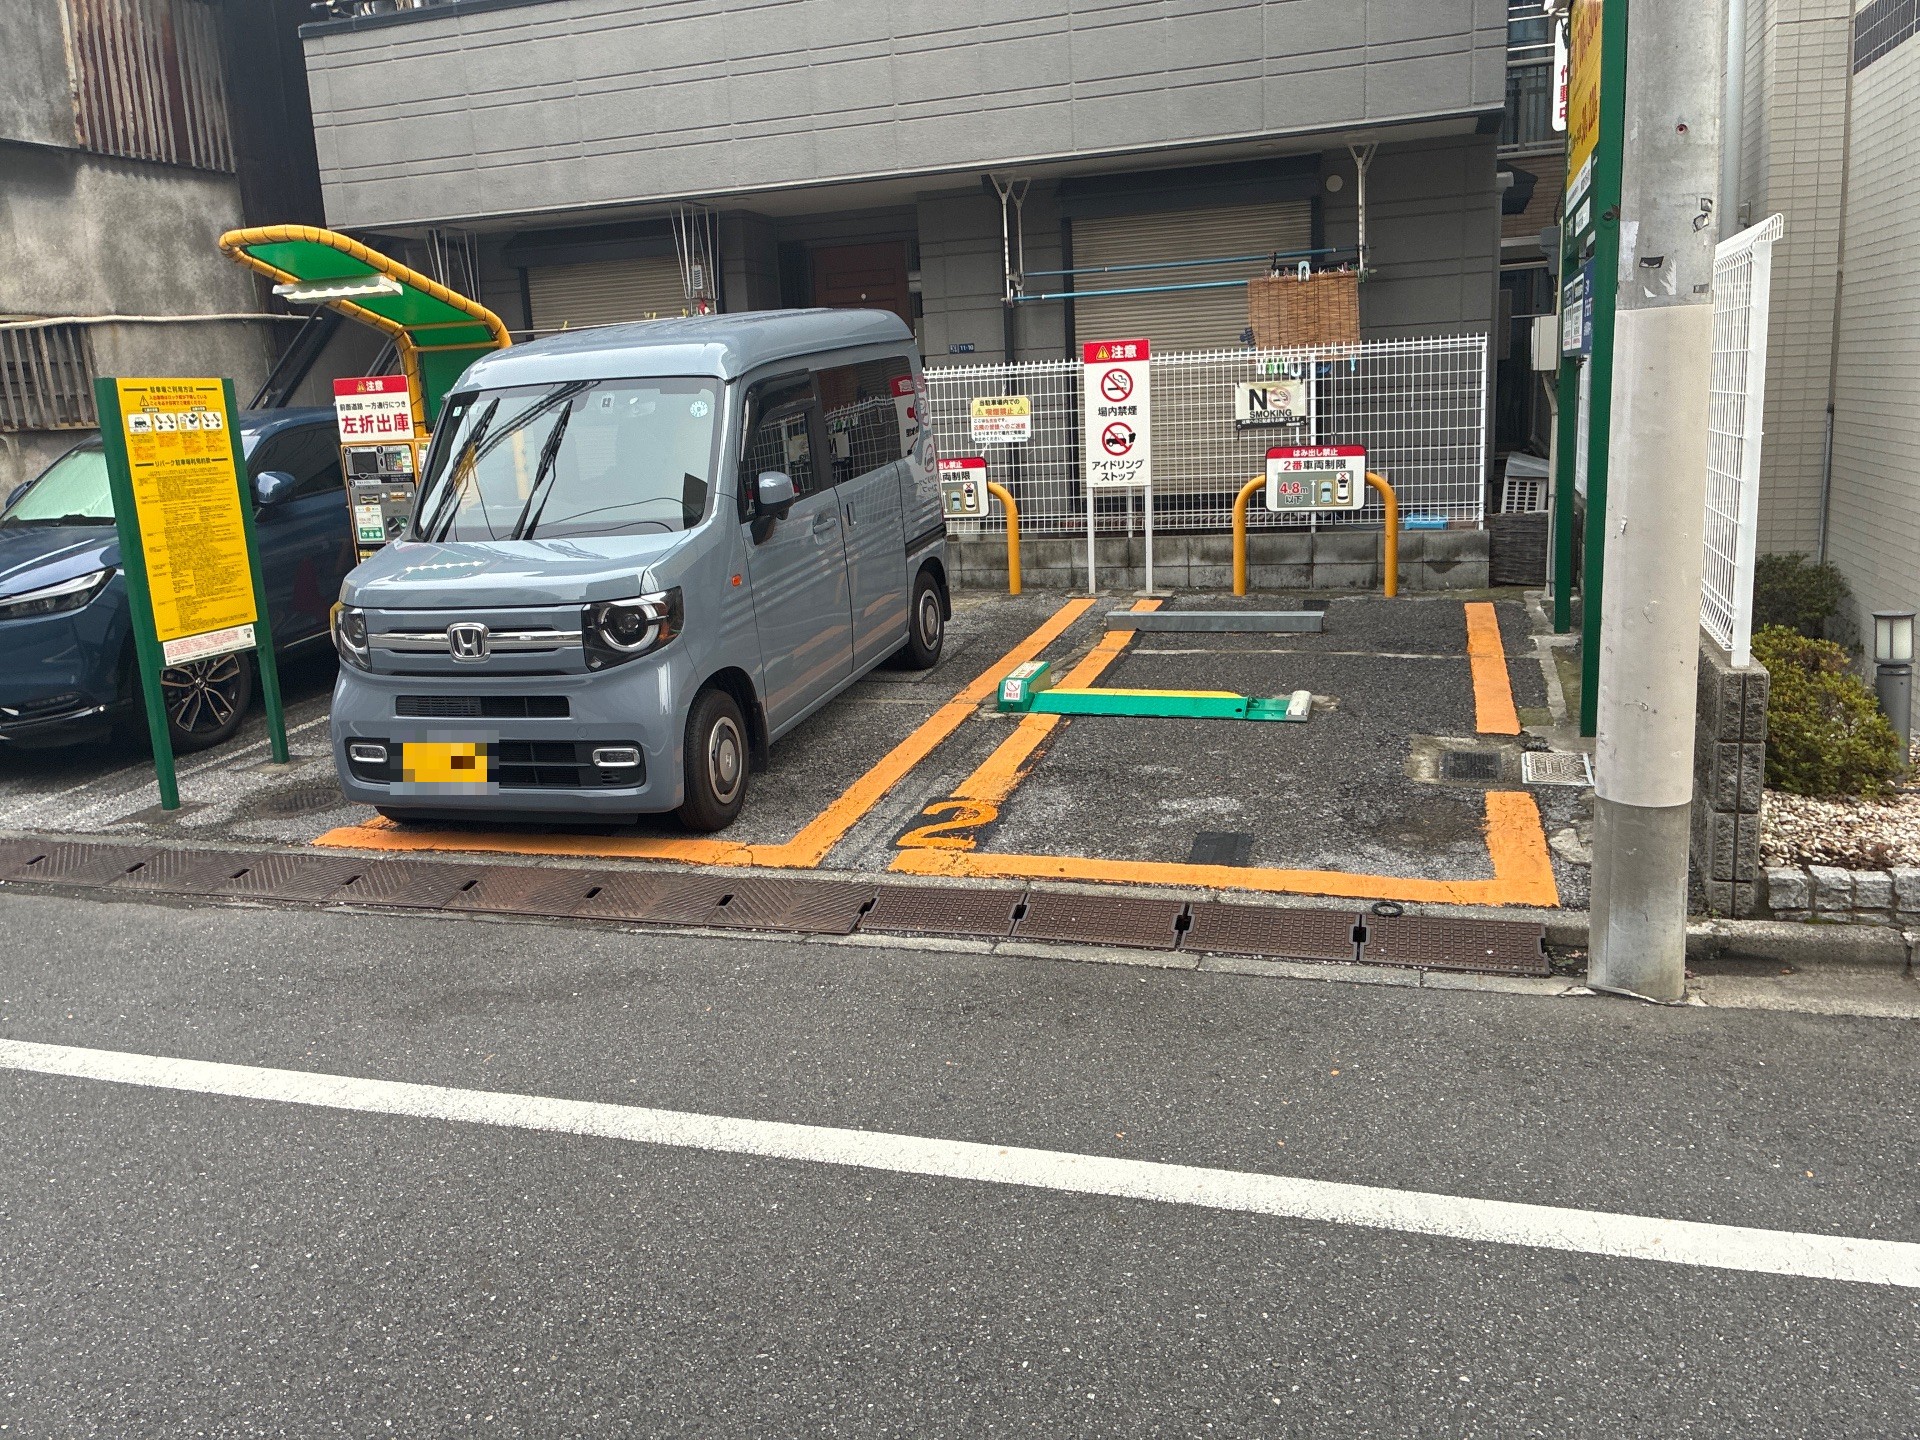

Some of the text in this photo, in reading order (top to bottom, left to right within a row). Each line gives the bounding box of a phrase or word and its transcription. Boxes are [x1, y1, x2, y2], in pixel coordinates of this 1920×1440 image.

[1111, 345, 1137, 359] 注意
[366, 380, 383, 391] 注意
[979, 398, 1020, 406] 当駐車場内での
[985, 408, 1014, 416] 喫煙禁止
[1098, 406, 1138, 416] 場内禁煙
[1249, 408, 1293, 419] SMOKING
[341, 412, 410, 434] 左折出庫
[1293, 448, 1339, 457] はみ出し禁止
[1092, 459, 1144, 471] アイドリング
[1101, 471, 1136, 481] ストップ
[1280, 482, 1308, 494] 4.8m
[1285, 496, 1303, 504] 以下
[896, 799, 998, 850] 2
